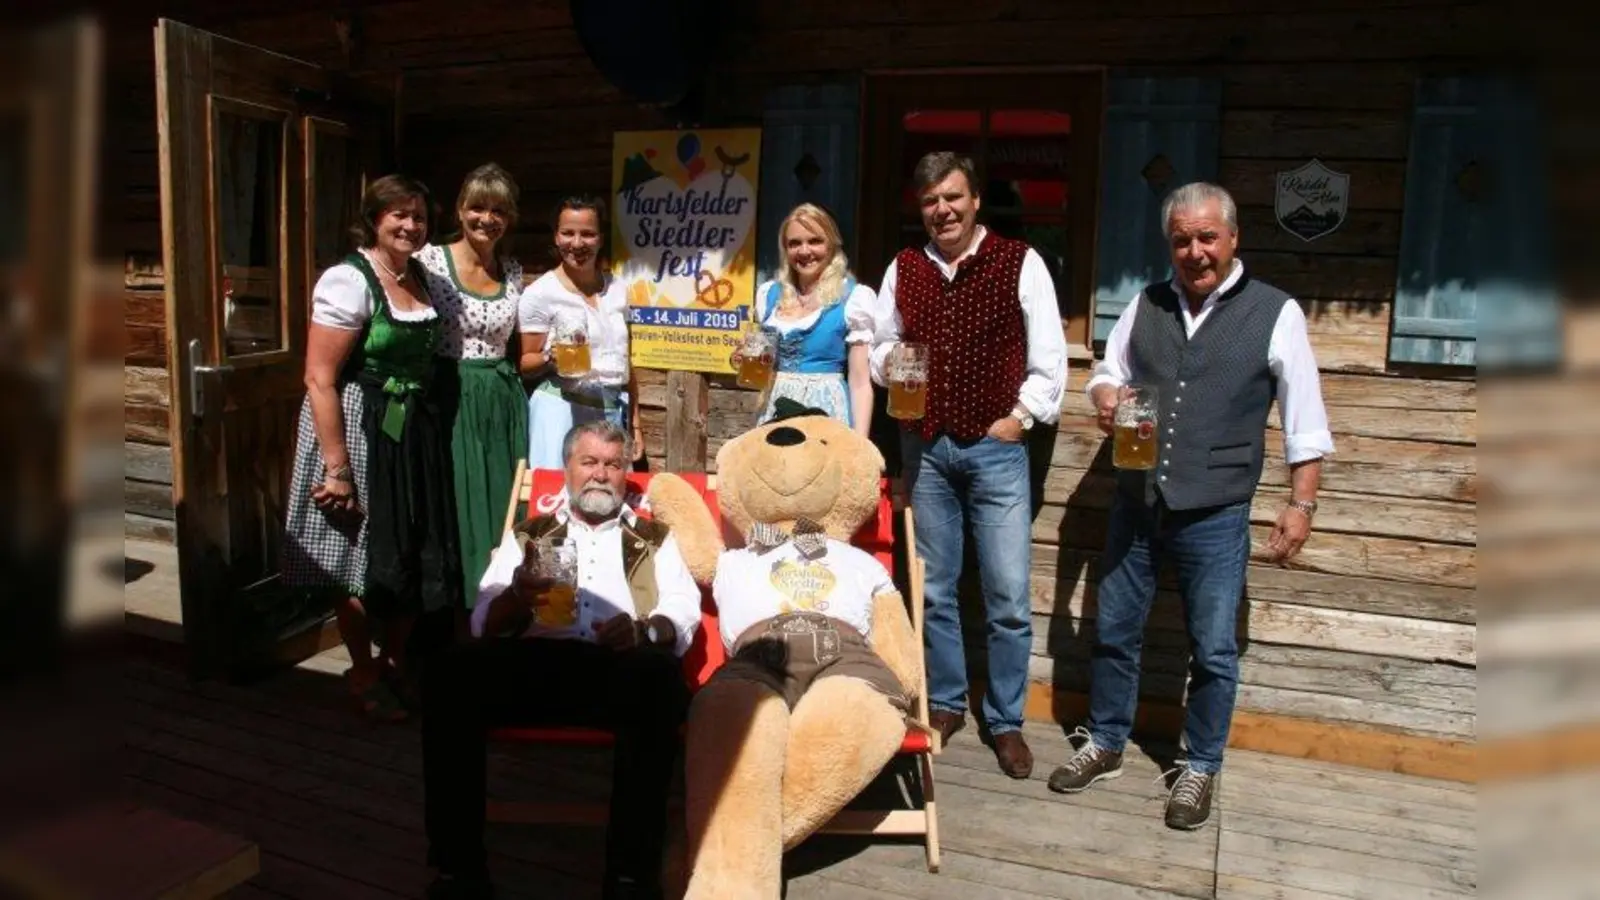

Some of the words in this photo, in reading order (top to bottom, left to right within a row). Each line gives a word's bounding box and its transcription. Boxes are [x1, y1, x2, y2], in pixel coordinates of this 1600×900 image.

[624, 186, 748, 222] Karlsfelder
[634, 217, 736, 248] Siedler-
[654, 249, 707, 283] fest
[653, 310, 672, 325] 14.
[675, 311, 698, 326] Juli
[703, 313, 738, 329] 2019
